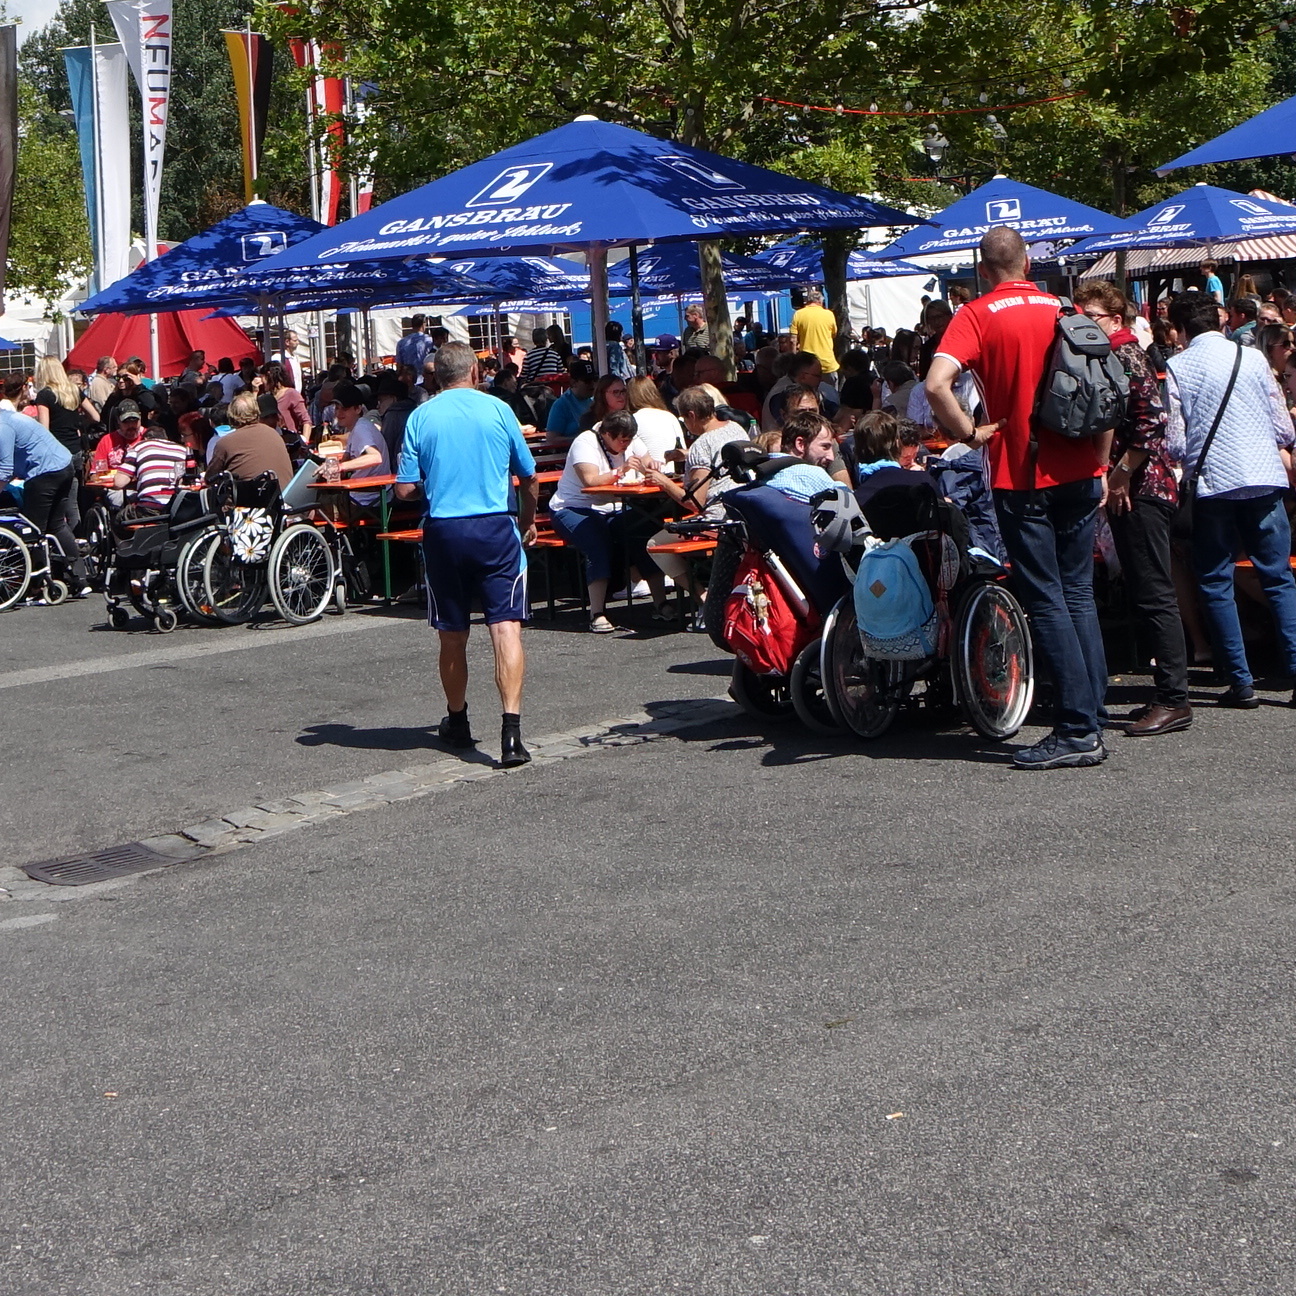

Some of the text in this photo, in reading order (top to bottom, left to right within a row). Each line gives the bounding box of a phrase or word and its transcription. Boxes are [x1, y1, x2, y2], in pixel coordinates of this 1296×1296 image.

[681, 192, 821, 211] GANSBRÄU
[378, 202, 573, 236] GANSBRÄU
[317, 221, 583, 259] Neumarkt's guter Schluck
[918, 235, 984, 251] Neumar
[987, 296, 1025, 313] BAYERN
